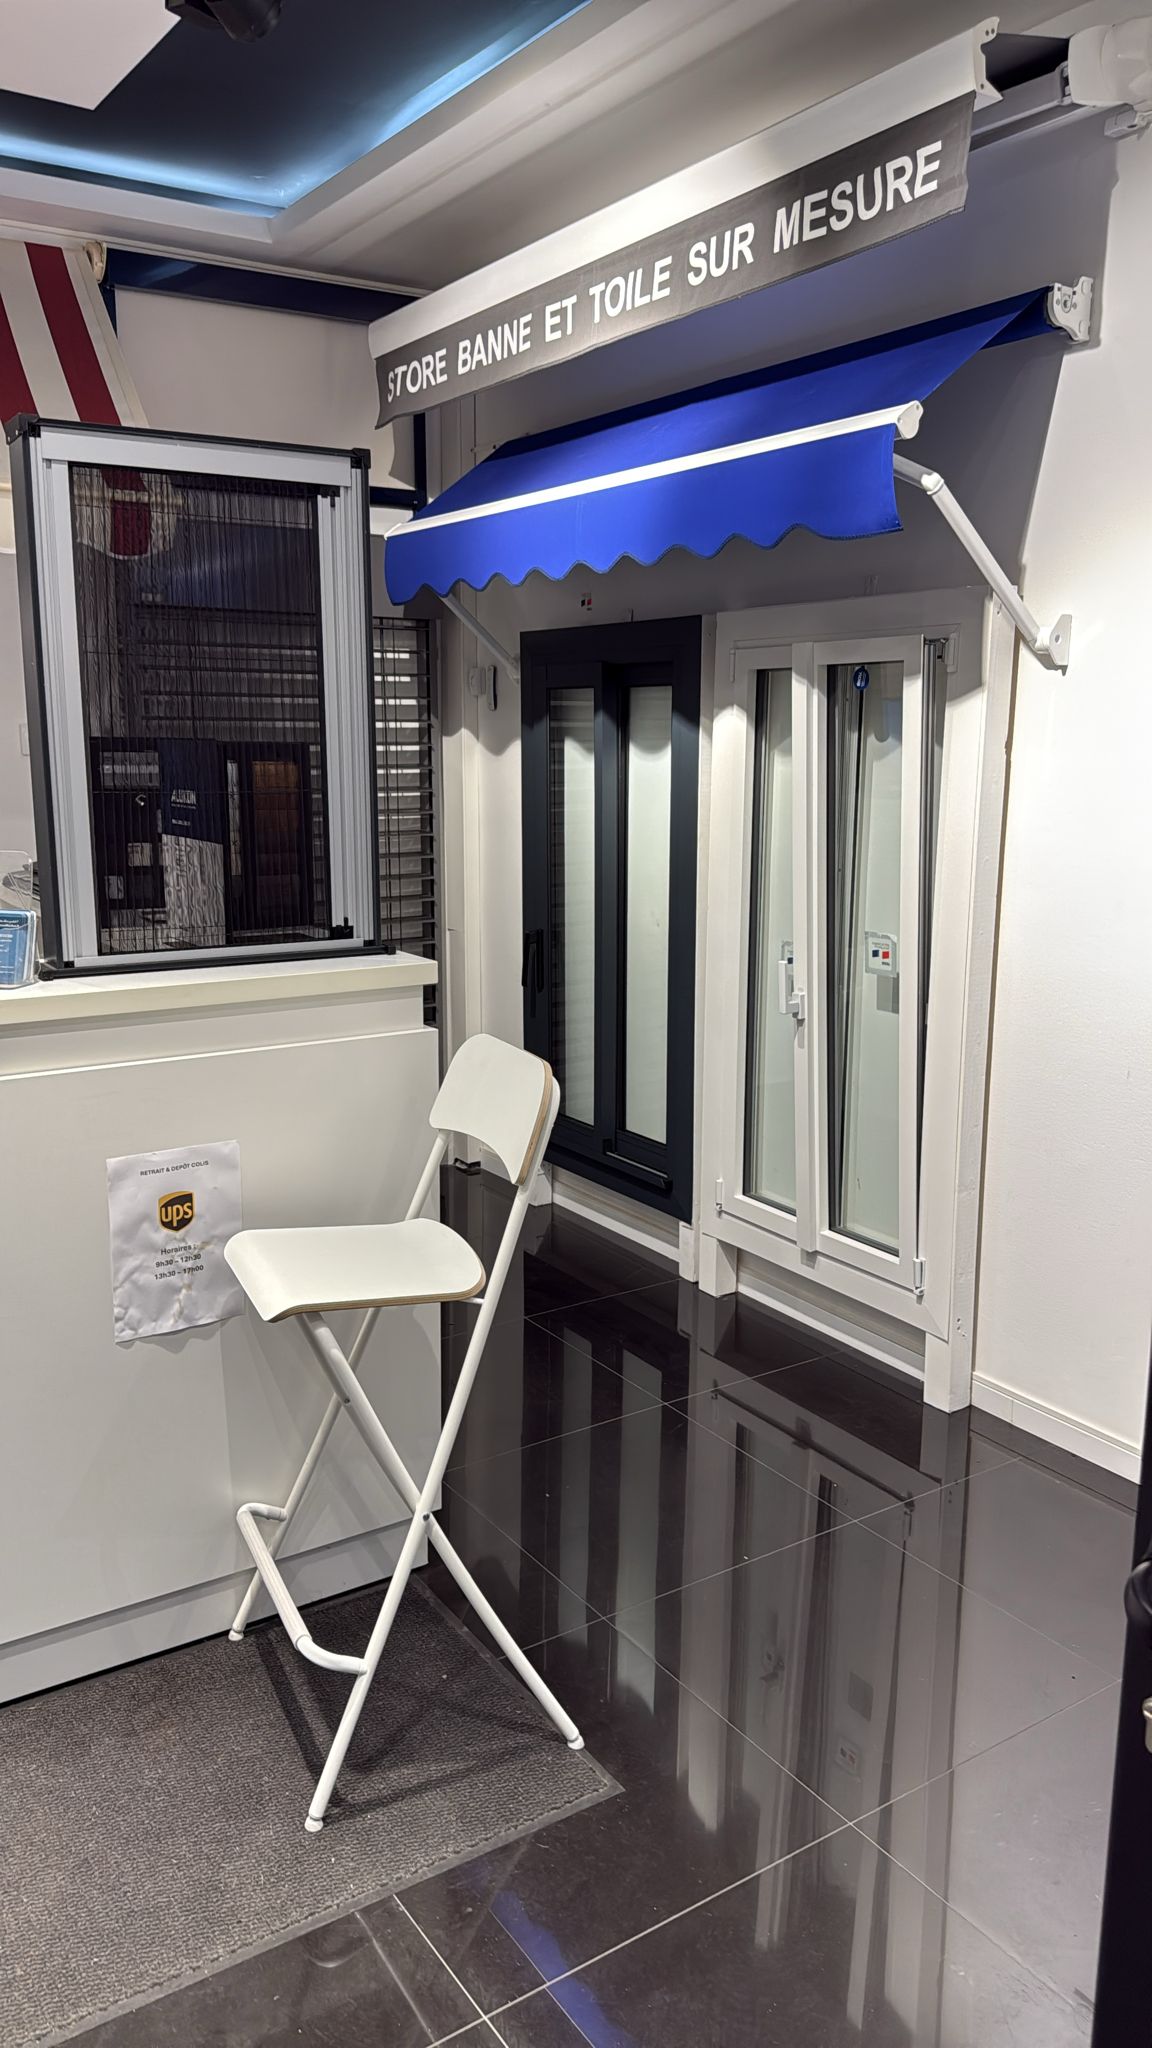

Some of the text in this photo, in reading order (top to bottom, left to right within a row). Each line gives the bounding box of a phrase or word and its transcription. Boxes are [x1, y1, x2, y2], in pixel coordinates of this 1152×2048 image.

[386, 140, 942, 403] STORE BANNE ET TOILE SUR MESURE
[140, 1167, 165, 1176] RETRAIT
[191, 1160, 209, 1168] COLIS
[161, 1203, 193, 1226] ups
[160, 1245, 192, 1255] Horaires
[155, 1259, 174, 1268] 9h30
[180, 1253, 202, 1263] 12h30
[154, 1270, 176, 1280] 13h30
[183, 1264, 204, 1274] 17h00
